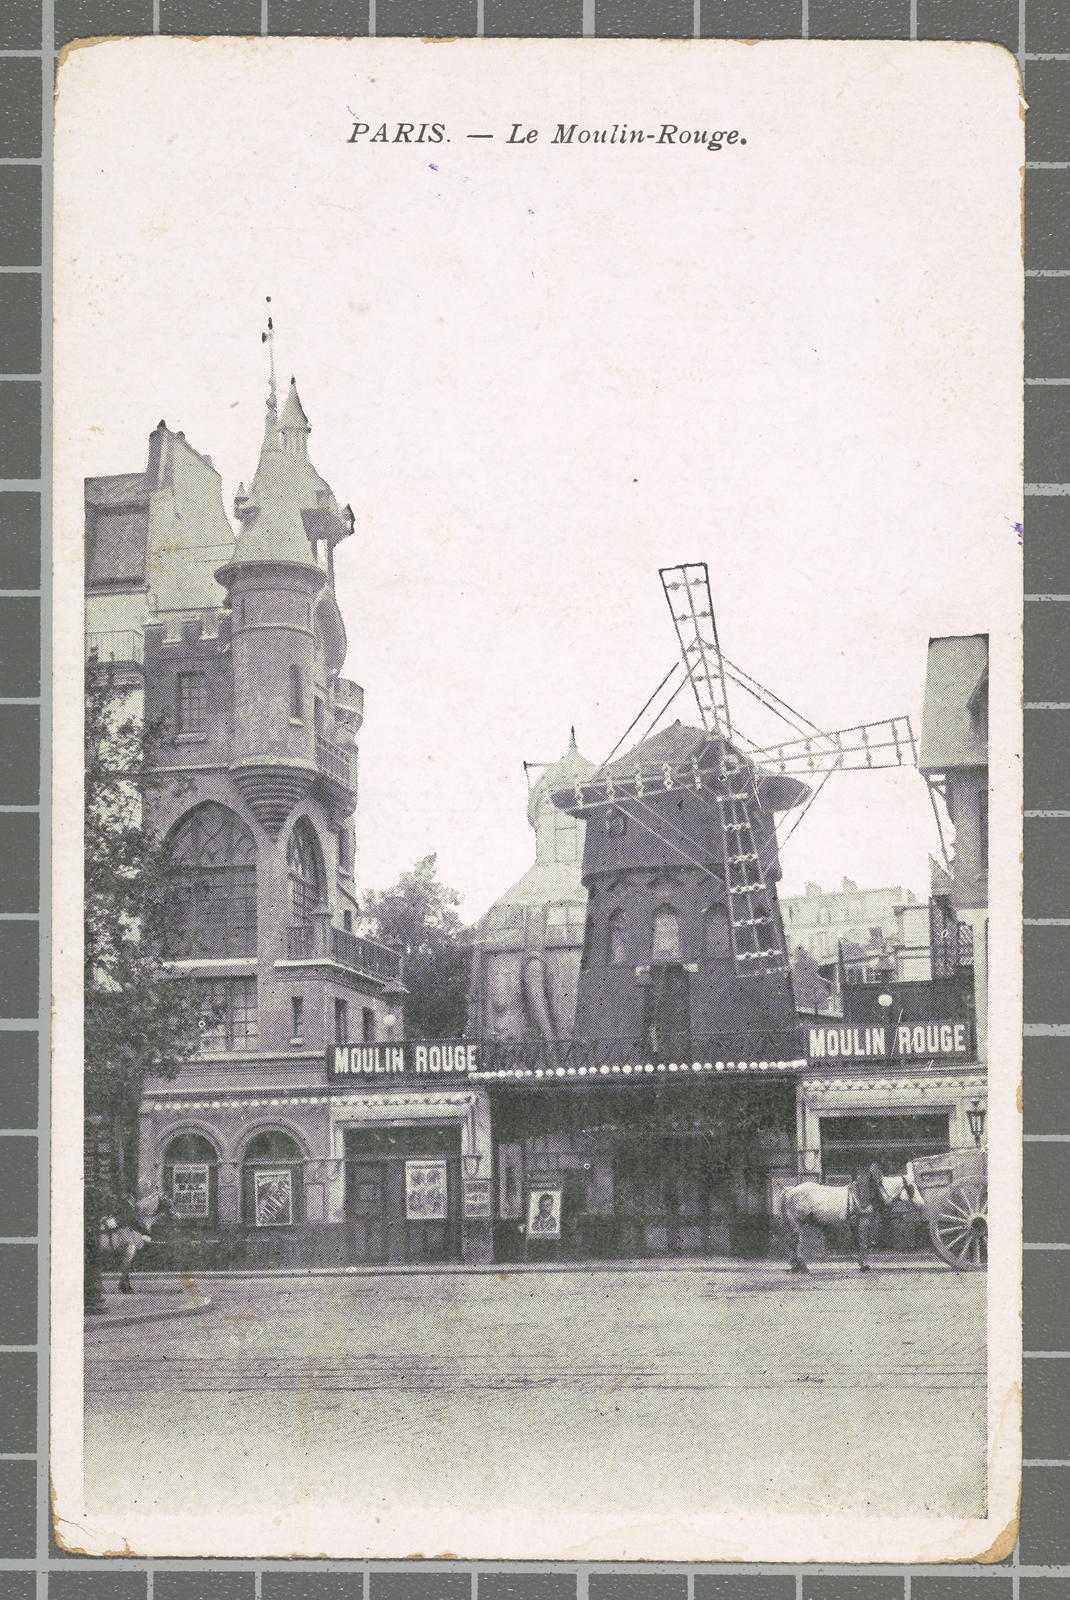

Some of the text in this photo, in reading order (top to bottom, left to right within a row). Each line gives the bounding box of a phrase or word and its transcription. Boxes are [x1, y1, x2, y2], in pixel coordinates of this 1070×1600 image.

[809, 1024, 966, 1057] MOULIN ROUGE
[335, 1045, 478, 1074] MOULIN ROUGE
